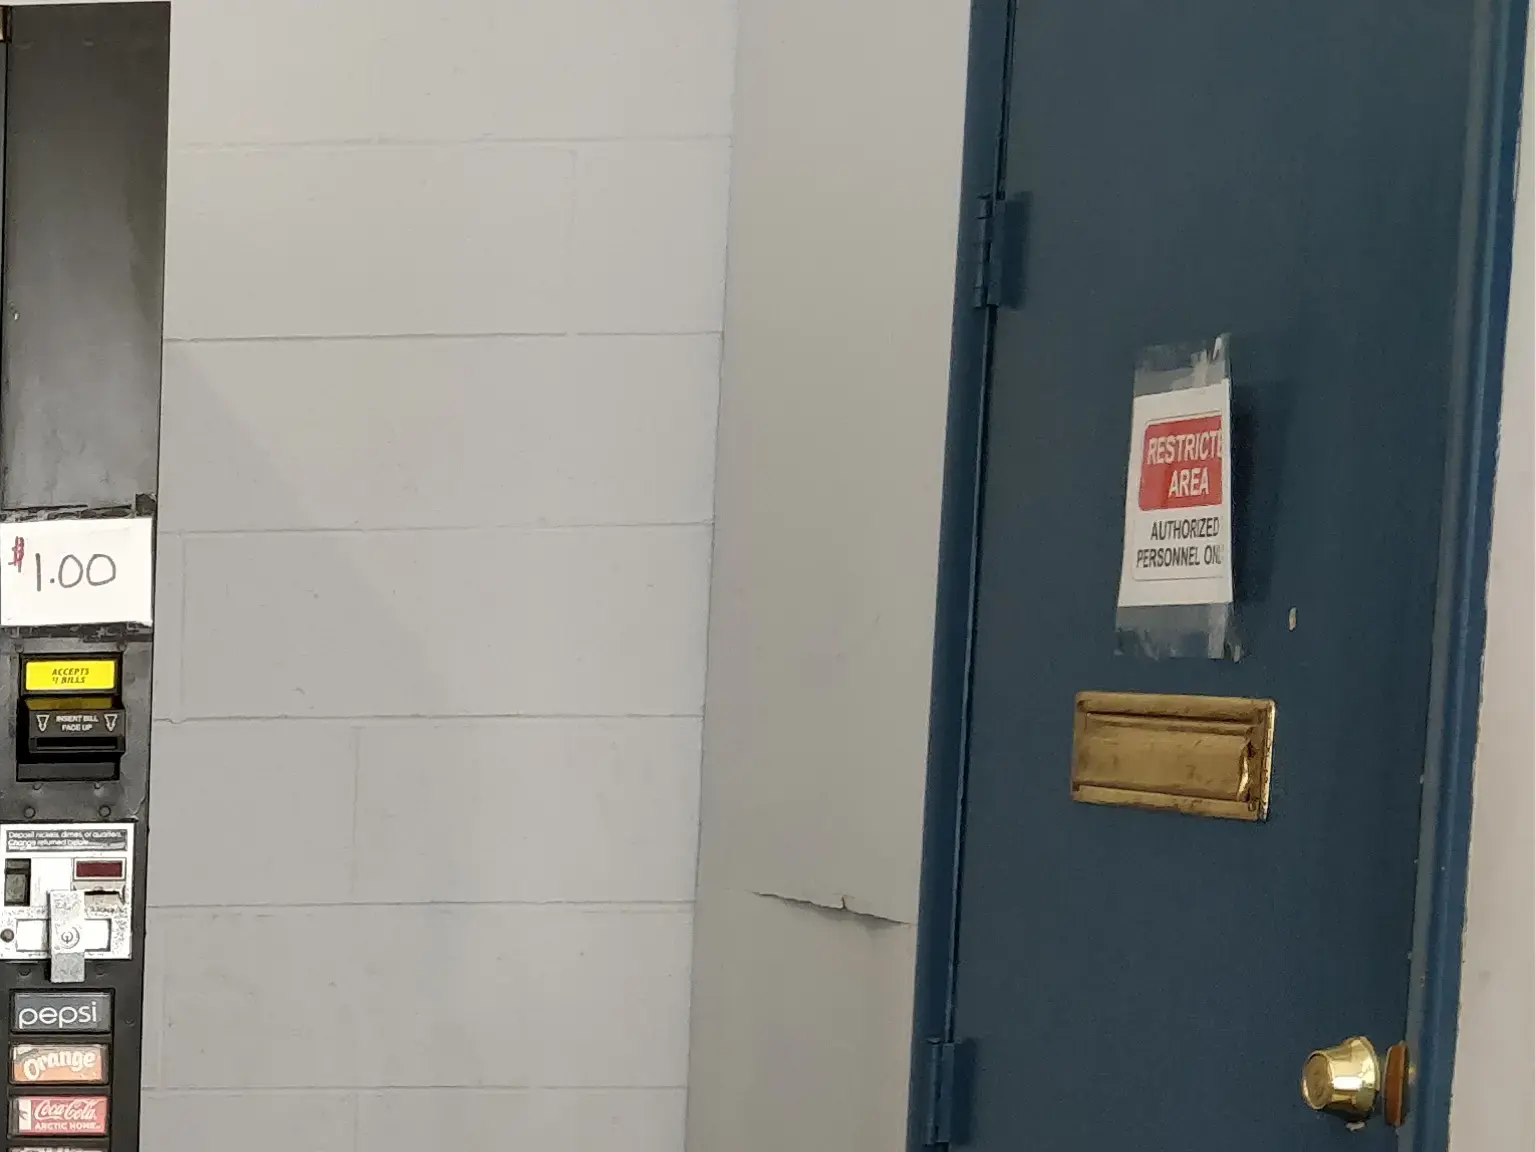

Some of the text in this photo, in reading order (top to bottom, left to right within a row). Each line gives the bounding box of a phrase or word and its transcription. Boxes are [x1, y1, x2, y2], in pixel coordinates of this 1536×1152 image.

[1168, 466, 1210, 498] AREA
[1150, 517, 1220, 540] AUTHORIZED
[1135, 546, 1201, 569] PERSONNEL
[52, 668, 90, 676] ACCEPTS
[61, 676, 86, 684] BILLS
[8, 839, 36, 848] Change
[19, 1001, 97, 1029] pepsi
[23, 1050, 97, 1081] Orange
[34, 1122, 67, 1131] ARCTIC
